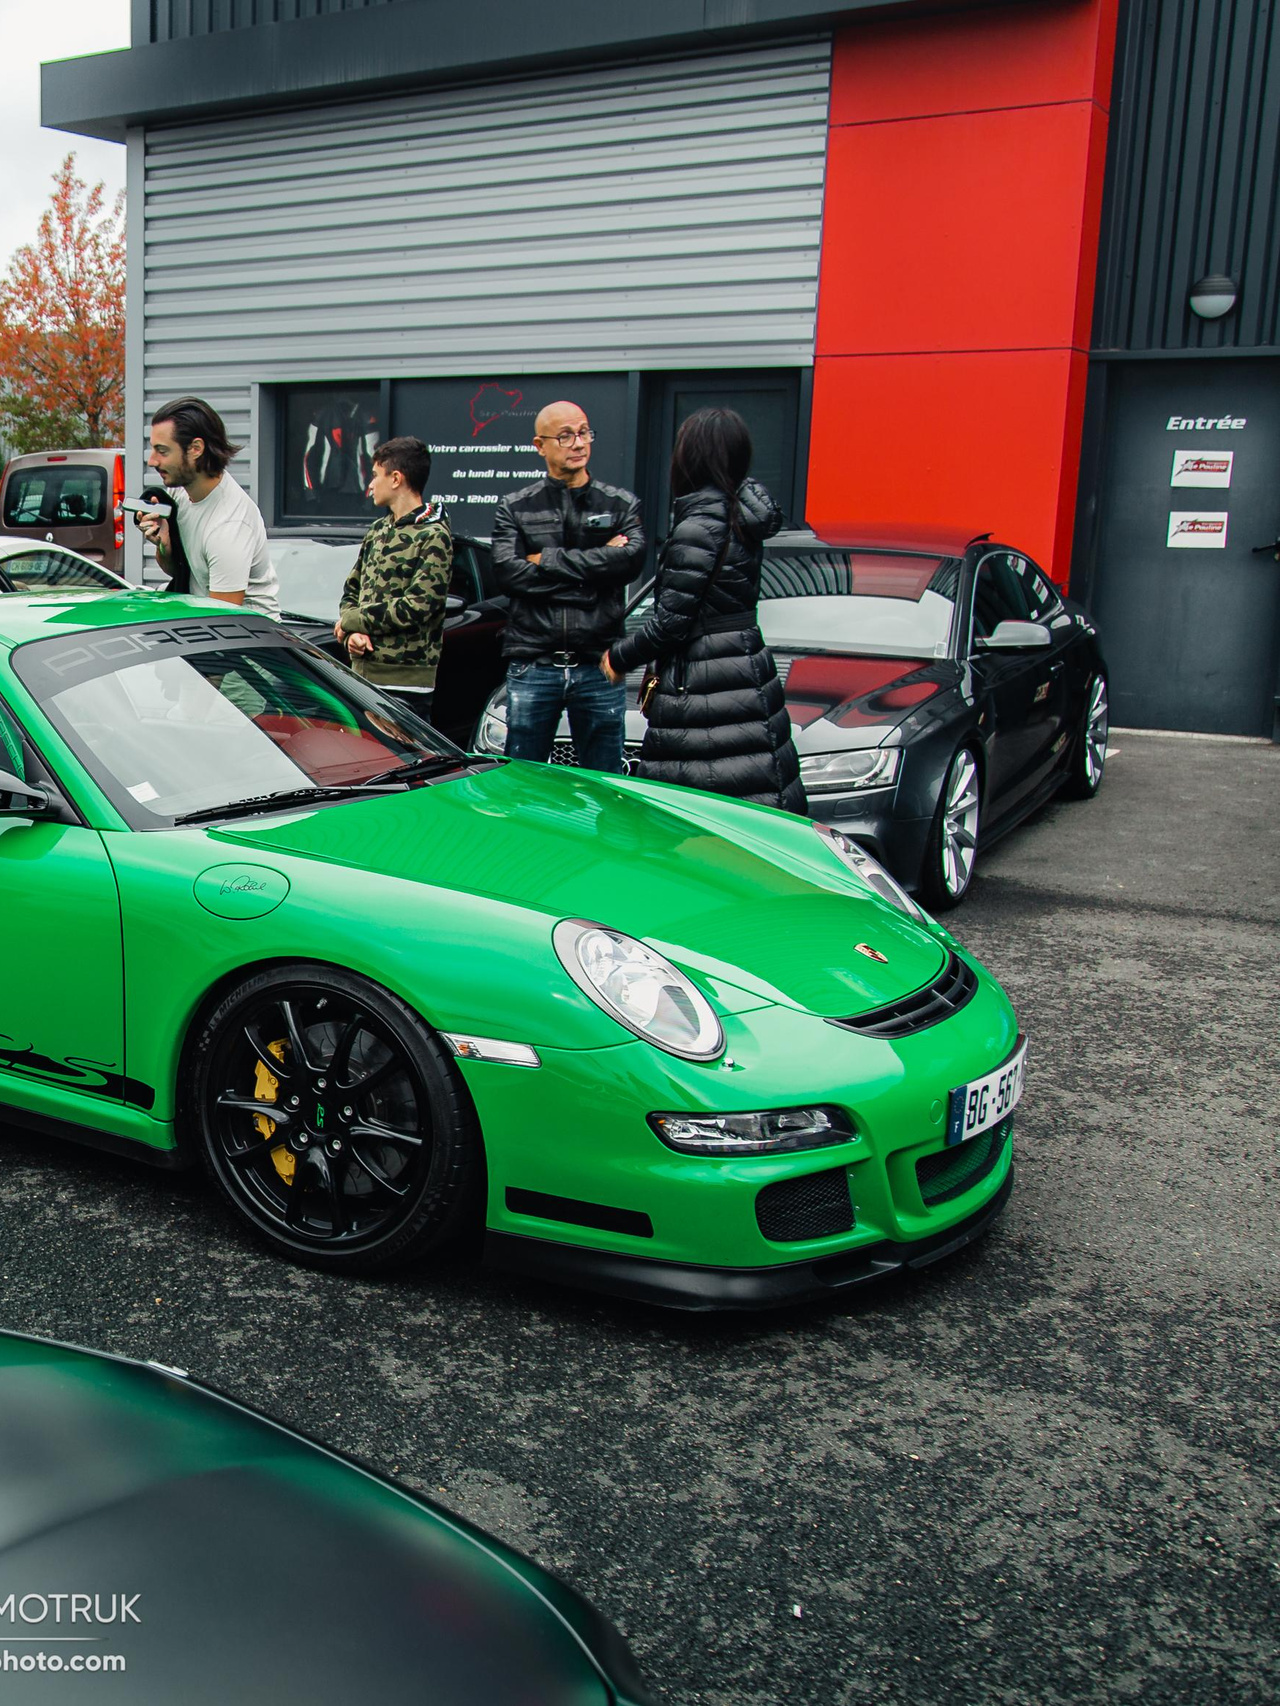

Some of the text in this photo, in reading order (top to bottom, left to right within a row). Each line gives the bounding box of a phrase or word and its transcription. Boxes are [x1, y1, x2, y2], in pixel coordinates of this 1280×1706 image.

[1166, 415, 1247, 431] Entrée
[428, 444, 456, 453] Votre
[458, 444, 511, 453] carrossier
[452, 469, 547, 479] du lundi au vendre
[467, 495, 499, 504] 12h00
